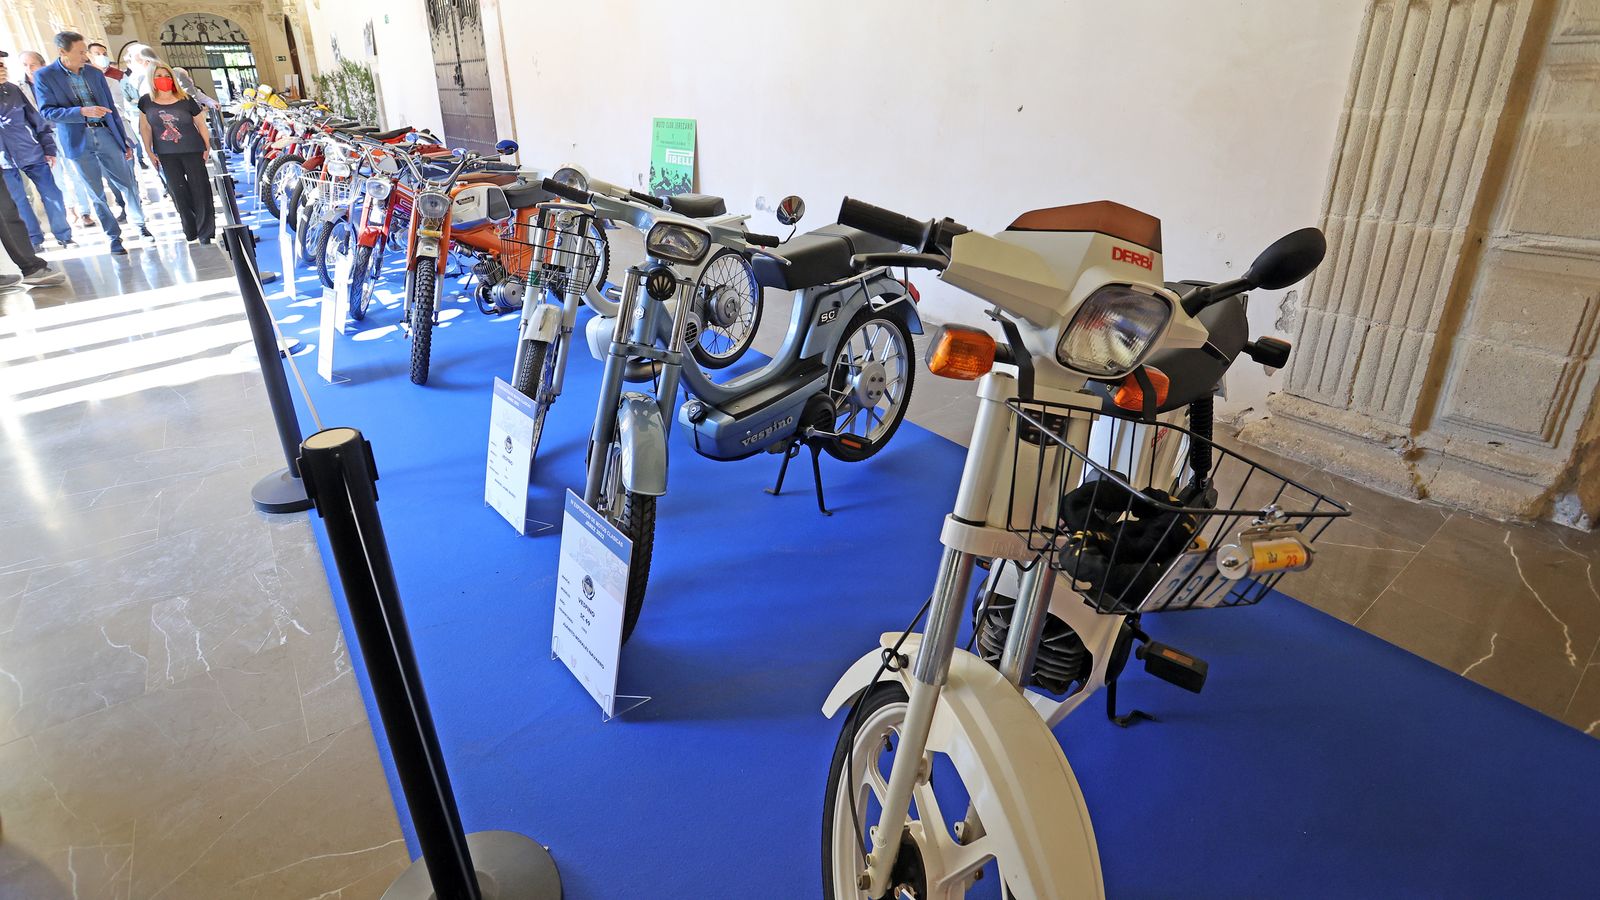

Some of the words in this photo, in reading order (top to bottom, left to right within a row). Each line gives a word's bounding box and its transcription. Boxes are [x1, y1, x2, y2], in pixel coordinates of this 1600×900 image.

[821, 310, 835, 322] SC
[741, 416, 793, 447] vespino
[1286, 554, 1298, 568] 23
[578, 597, 596, 617] VESPINO
